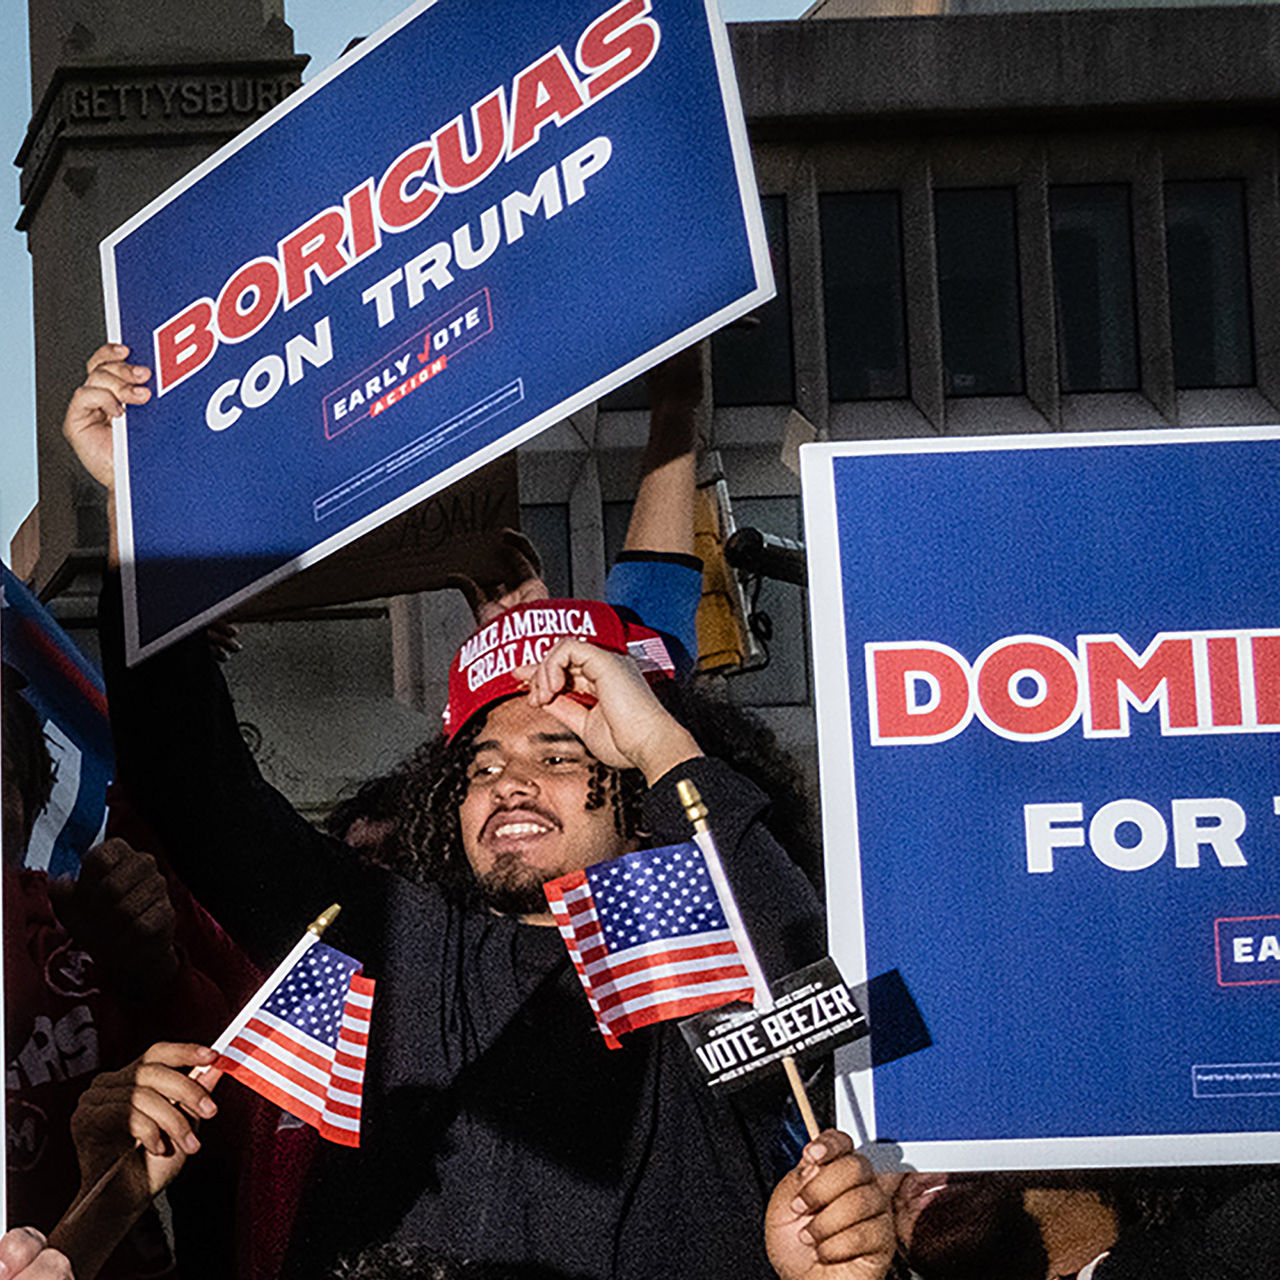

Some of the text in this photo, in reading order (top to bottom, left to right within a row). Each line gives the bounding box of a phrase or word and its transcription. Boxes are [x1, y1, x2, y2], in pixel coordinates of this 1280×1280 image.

[153, 0, 661, 397] BORICUAS
[205, 136, 612, 431] CON TRUMP
[333, 352, 411, 421] EARLY
[373, 360, 443, 414] ACTION
[458, 608, 597, 673] MAKE AMERICA
[467, 643, 518, 692] GREAT
[1023, 798, 1248, 873] FOR
[695, 1023, 767, 1075] VOTE
[760, 983, 857, 1048] BEEZER
